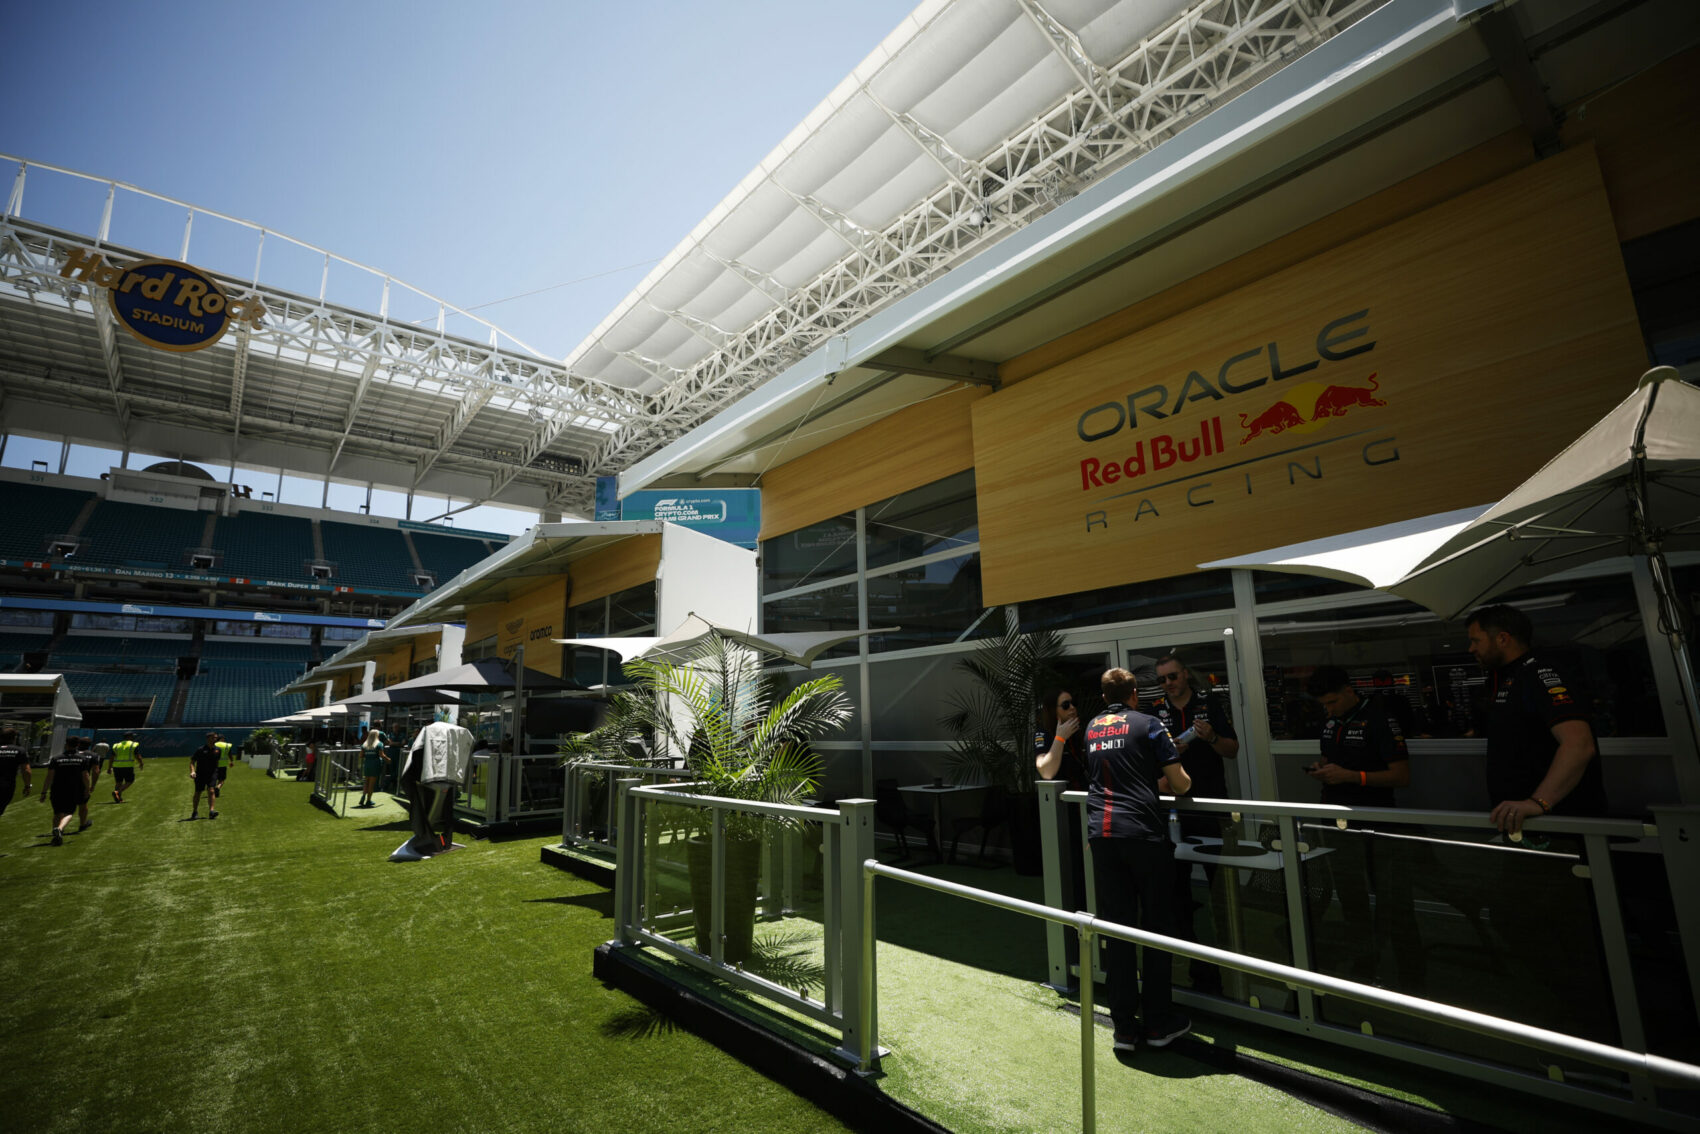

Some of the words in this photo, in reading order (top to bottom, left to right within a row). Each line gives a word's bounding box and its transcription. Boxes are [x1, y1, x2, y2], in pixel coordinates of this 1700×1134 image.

[60, 248, 176, 302] Hard
[173, 278, 267, 331] Rock
[132, 307, 205, 335] STADIUM
[1077, 308, 1377, 442] ORACLE
[1085, 436, 1401, 533] RACING
[530, 625, 553, 641] aramco
[1089, 739, 1114, 753] Mobil
